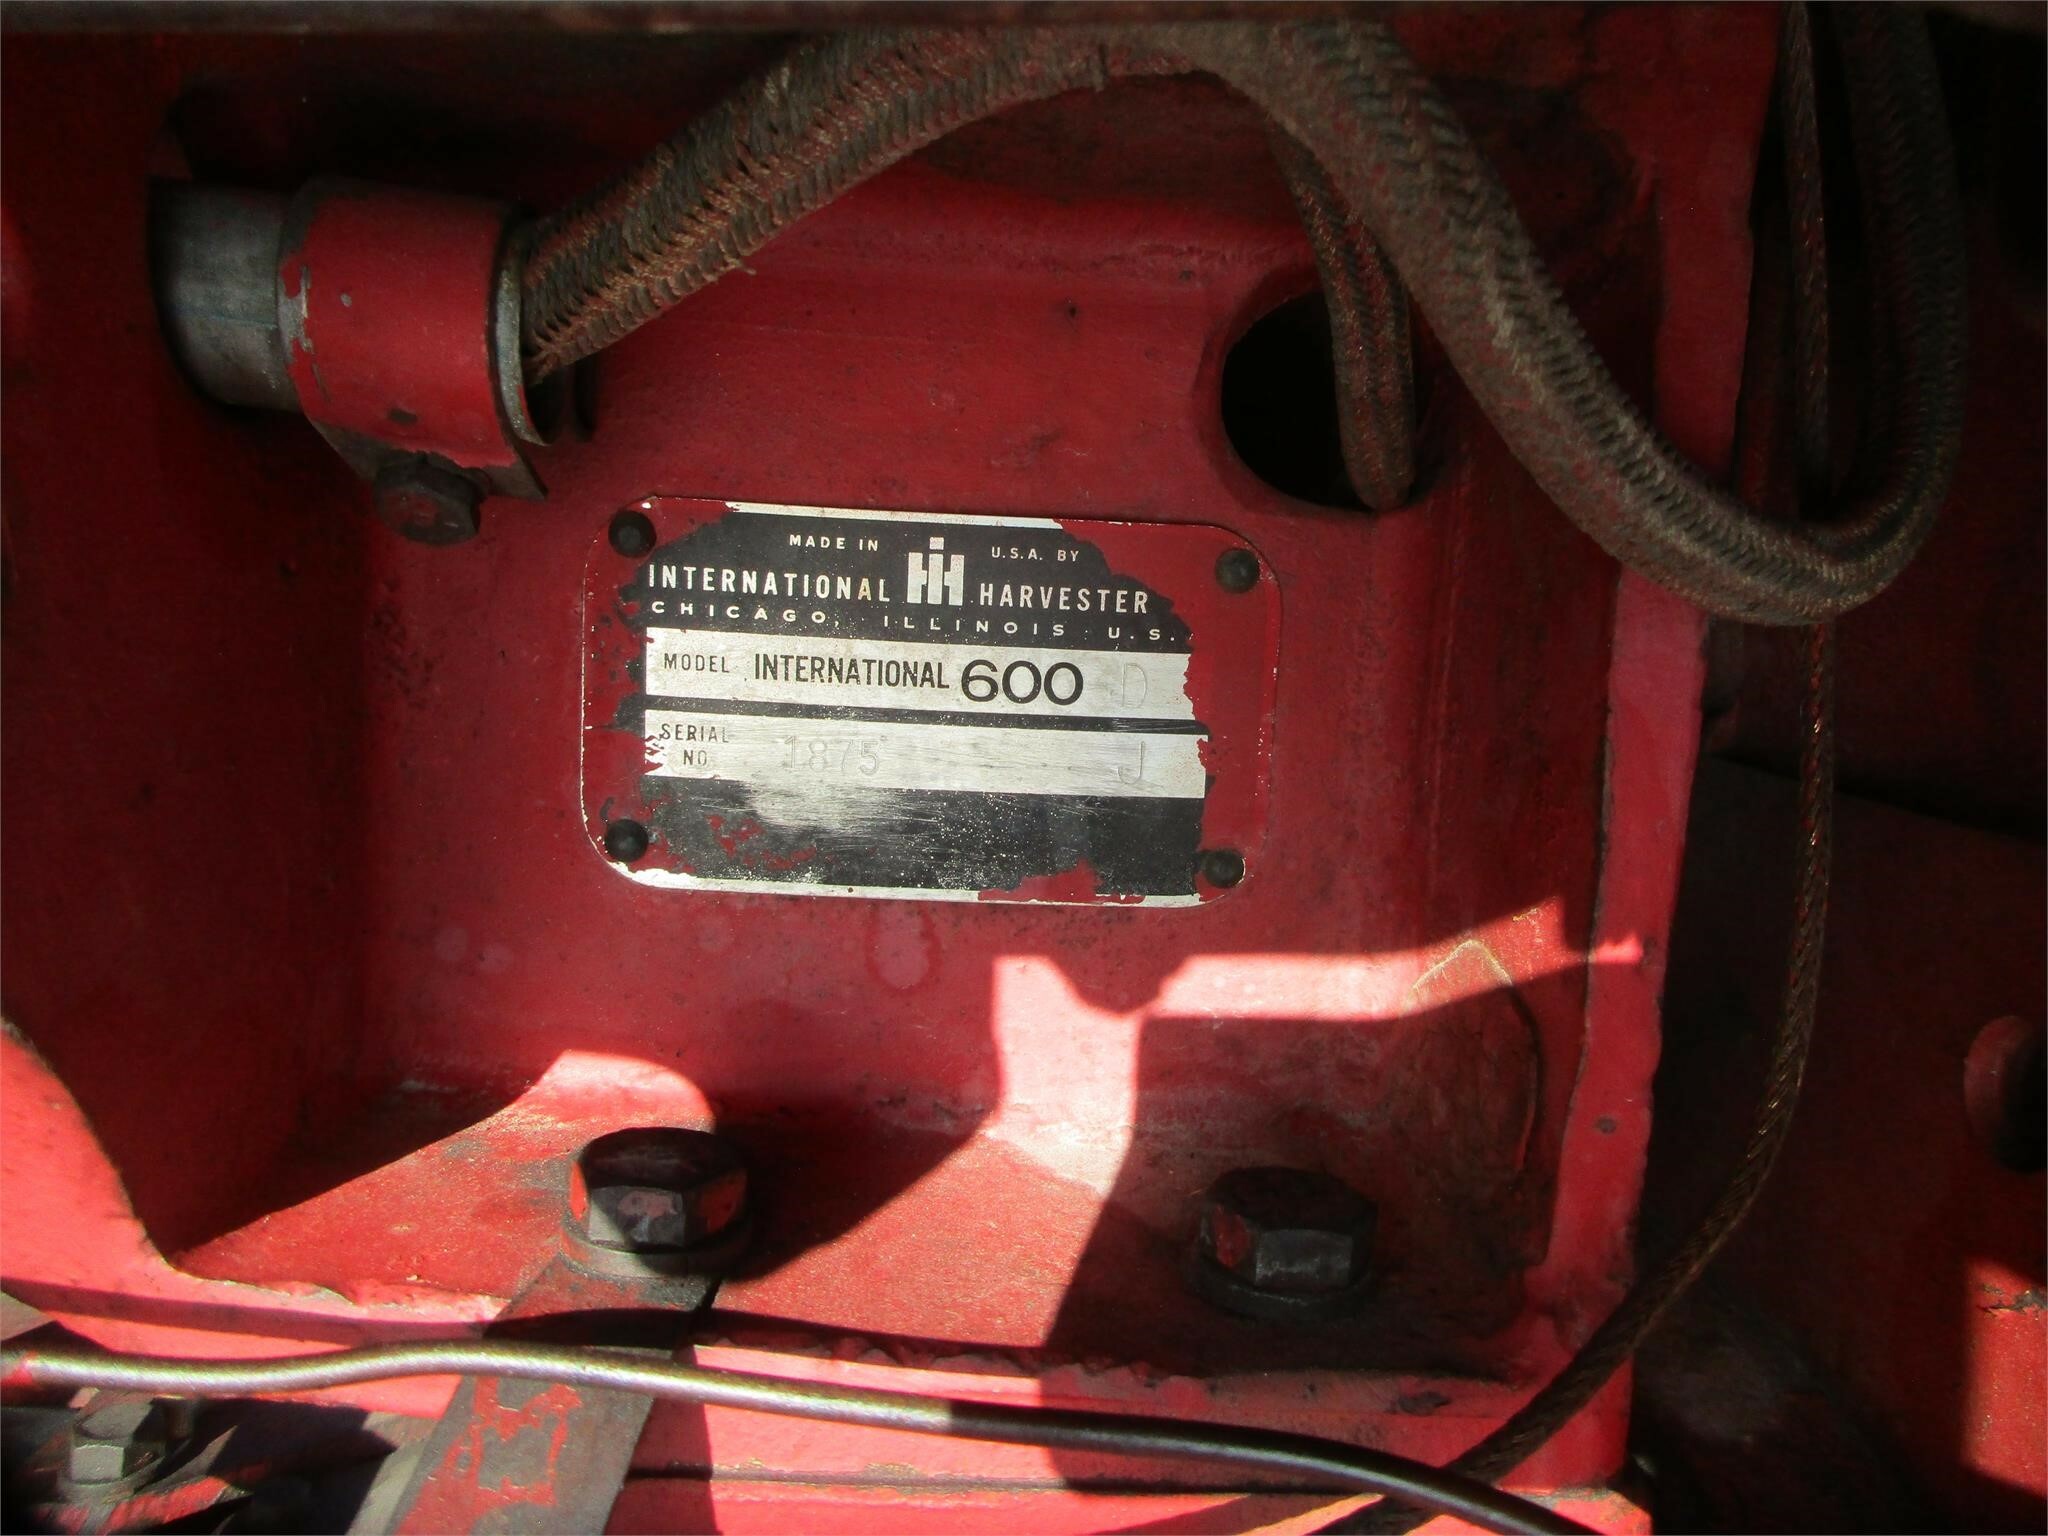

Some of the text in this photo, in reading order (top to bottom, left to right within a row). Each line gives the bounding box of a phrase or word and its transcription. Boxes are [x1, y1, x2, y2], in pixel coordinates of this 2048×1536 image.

[789, 534, 1080, 562] MADE IN U.S.A. BY
[648, 563, 1149, 615] INTERNATIONAL HARVESTER
[650, 600, 841, 628] CHICAGO,
[883, 615, 1065, 637] ILLINOIS
[663, 652, 1148, 709] MODEL INTERNATIONAL 600 D
[659, 722, 730, 744] SERIAL
[783, 735, 1146, 785] 1875 J
